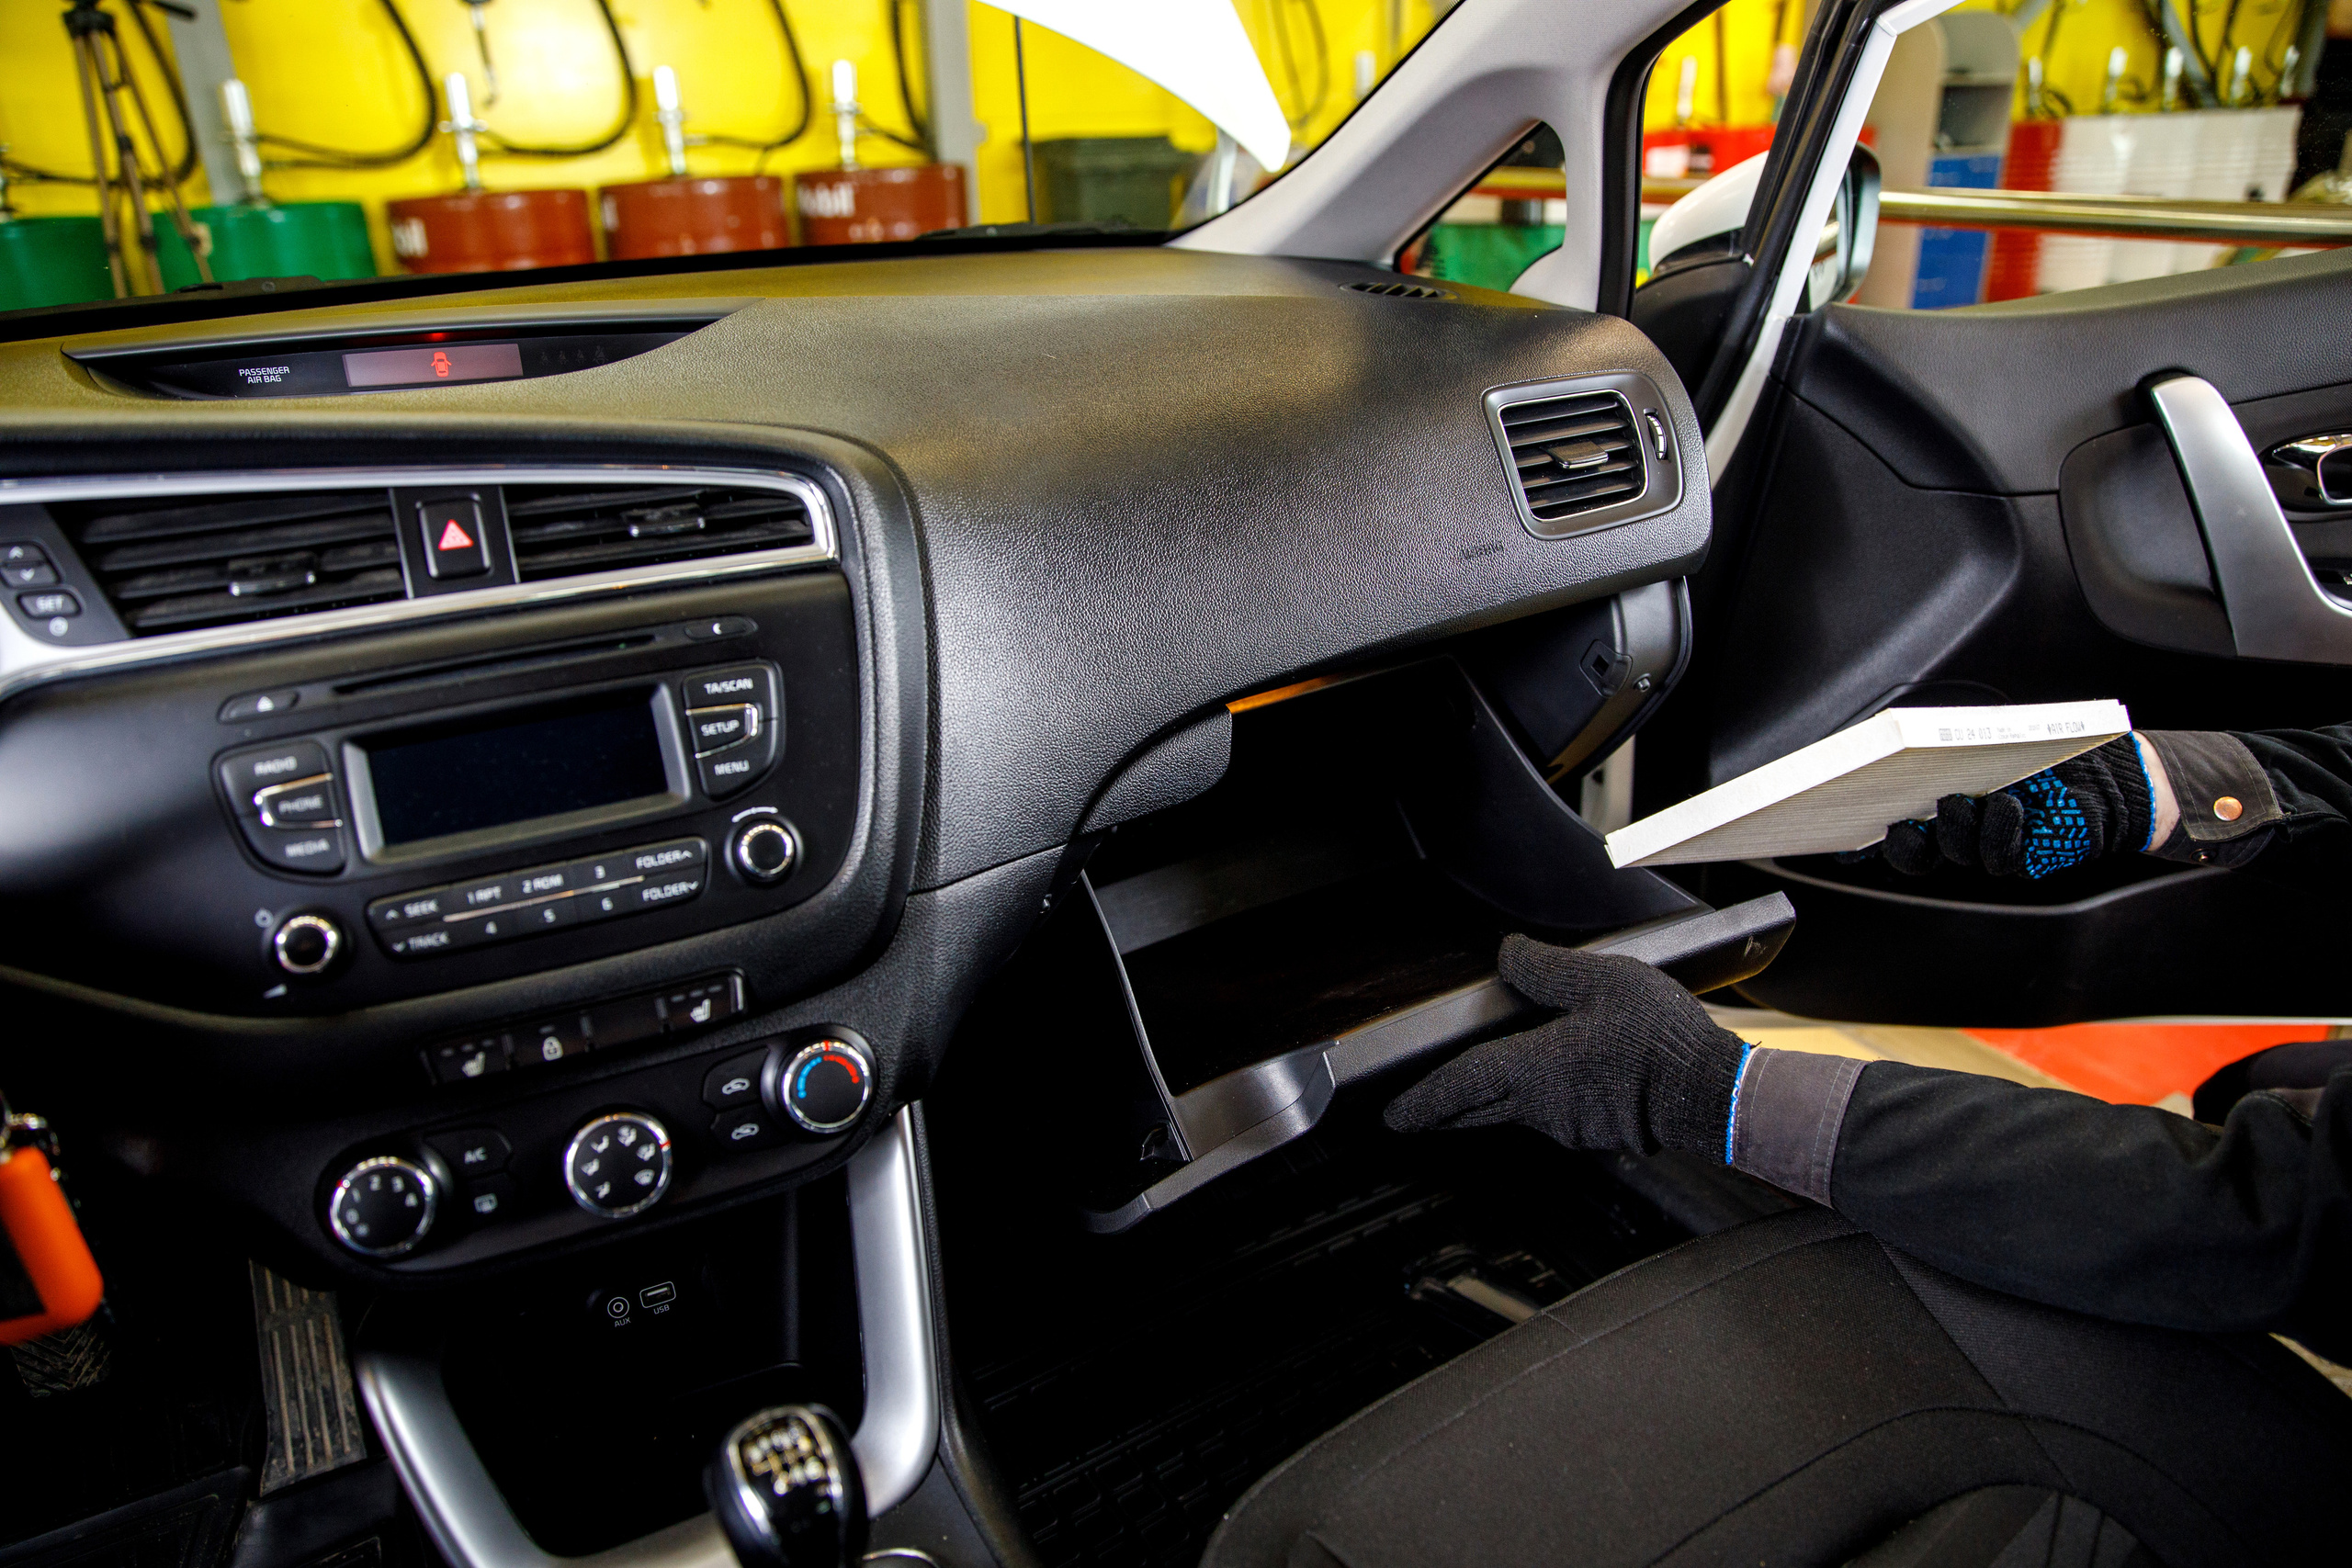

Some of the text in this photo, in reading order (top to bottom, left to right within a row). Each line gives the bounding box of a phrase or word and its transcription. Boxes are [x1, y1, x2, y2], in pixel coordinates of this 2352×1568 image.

[239, 366, 290, 377] PASSENGER
[247, 374, 282, 384] AIR BAG
[704, 678, 753, 694] TA/SCAN
[701, 719, 740, 736] SETUP
[2051, 722, 2064, 735] AIR
[254, 756, 298, 776] RADIO
[714, 760, 750, 775] MENU
[278, 795, 322, 814] PHONE
[285, 838, 330, 858] MEDIA
[636, 850, 683, 869] FOLDER
[522, 879, 533, 894] 2
[642, 882, 689, 901] FOLDER
[404, 899, 438, 918] SEEK
[408, 931, 449, 951] TRACK
[369, 1174, 381, 1191] 2
[653, 1304, 670, 1314] USB
[614, 1317, 631, 1327] AUX
